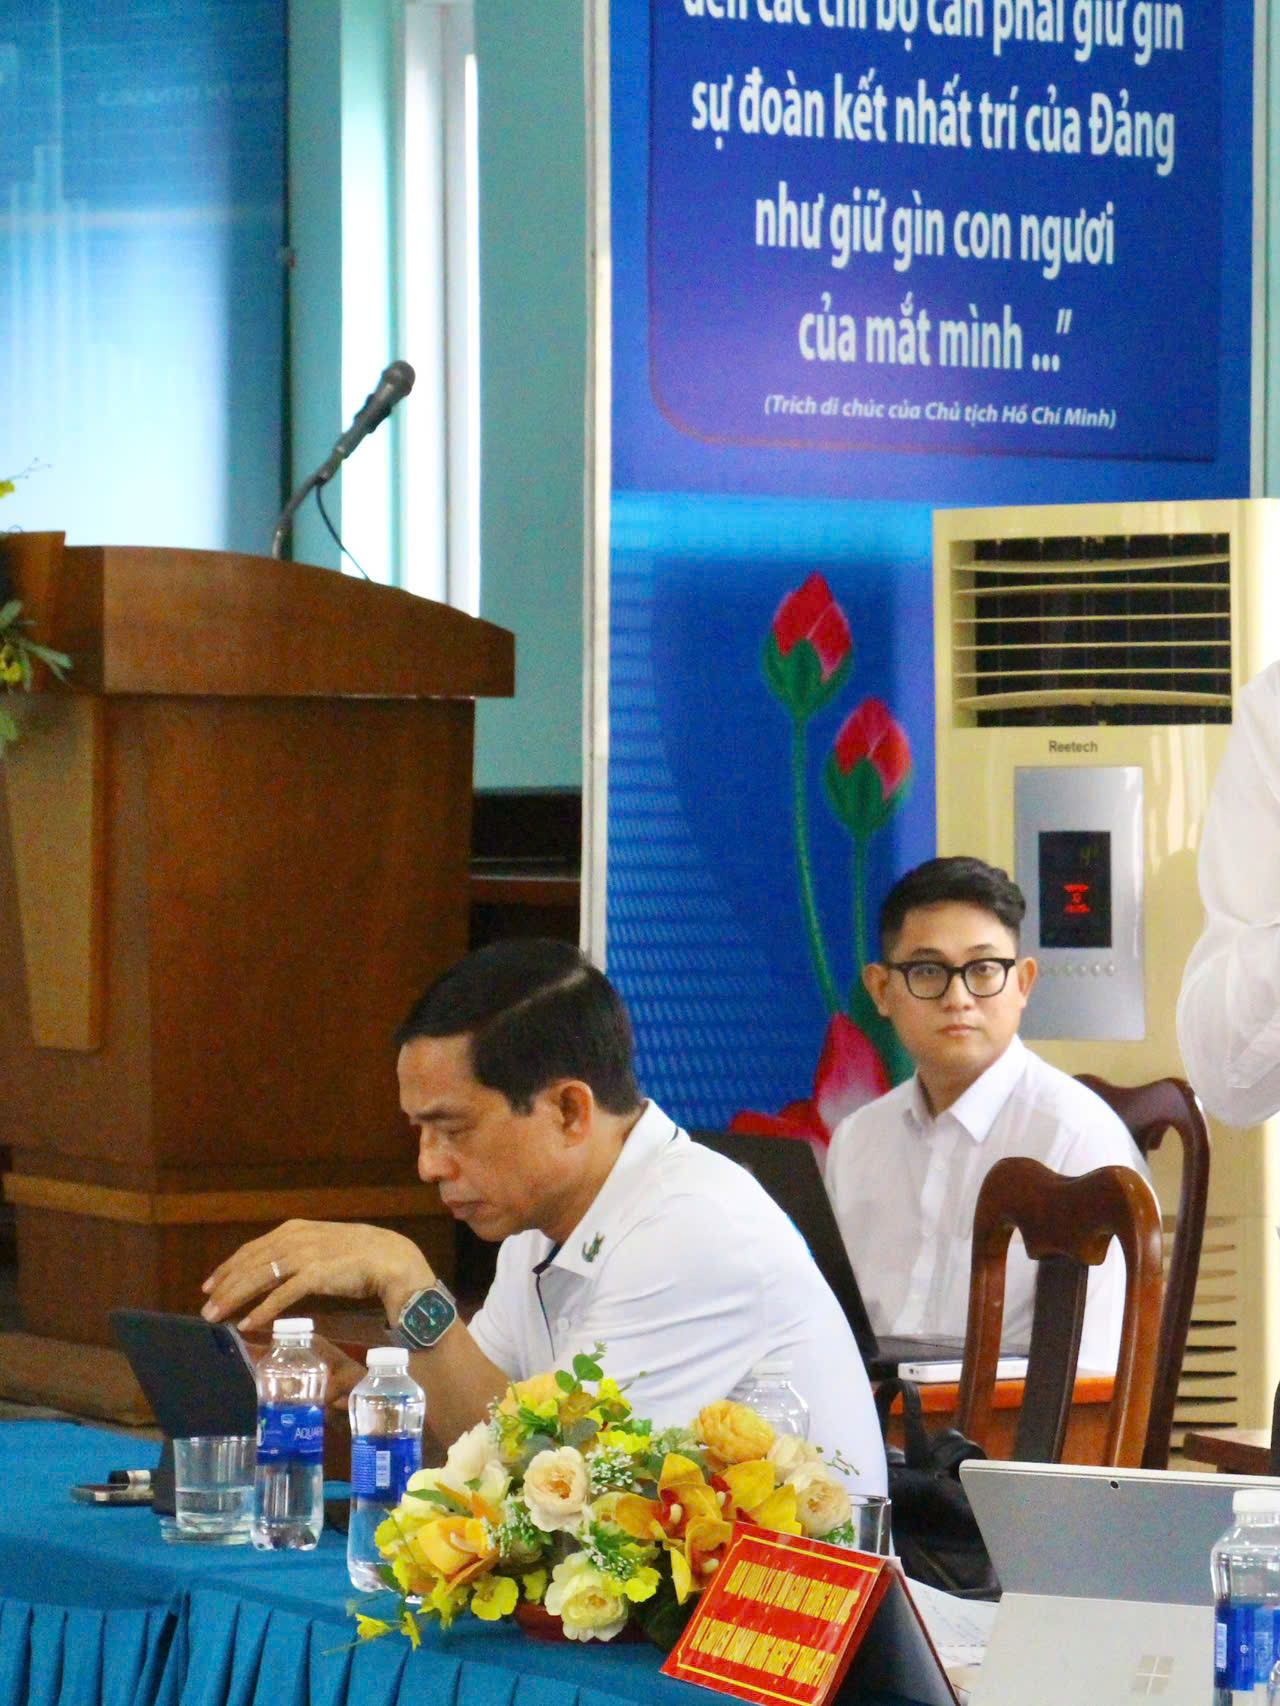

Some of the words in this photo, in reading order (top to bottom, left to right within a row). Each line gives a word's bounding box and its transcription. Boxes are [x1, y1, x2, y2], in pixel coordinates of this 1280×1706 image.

[691, 74, 733, 150] sự
[738, 66, 825, 138] đoàn
[834, 67, 887, 142] kết
[895, 73, 972, 148] nhất
[978, 85, 1019, 150] trí
[1024, 83, 1082, 153] của
[1088, 88, 1175, 176] Đảng
[755, 180, 825, 249] như
[829, 186, 887, 269] giữ
[892, 189, 945, 272] gìn
[953, 211, 1011, 259] con
[1020, 200, 1115, 280] ngươi
[799, 291, 857, 362] của
[866, 291, 931, 367] mắt
[938, 303, 1023, 370] mình
[842, 398, 885, 418] chúc
[888, 399, 921, 420] của
[964, 403, 999, 428] tịch
[1031, 406, 1062, 425] Chí
[1064, 407, 1118, 429] Minh)
[1047, 740, 1099, 753] Reetech
